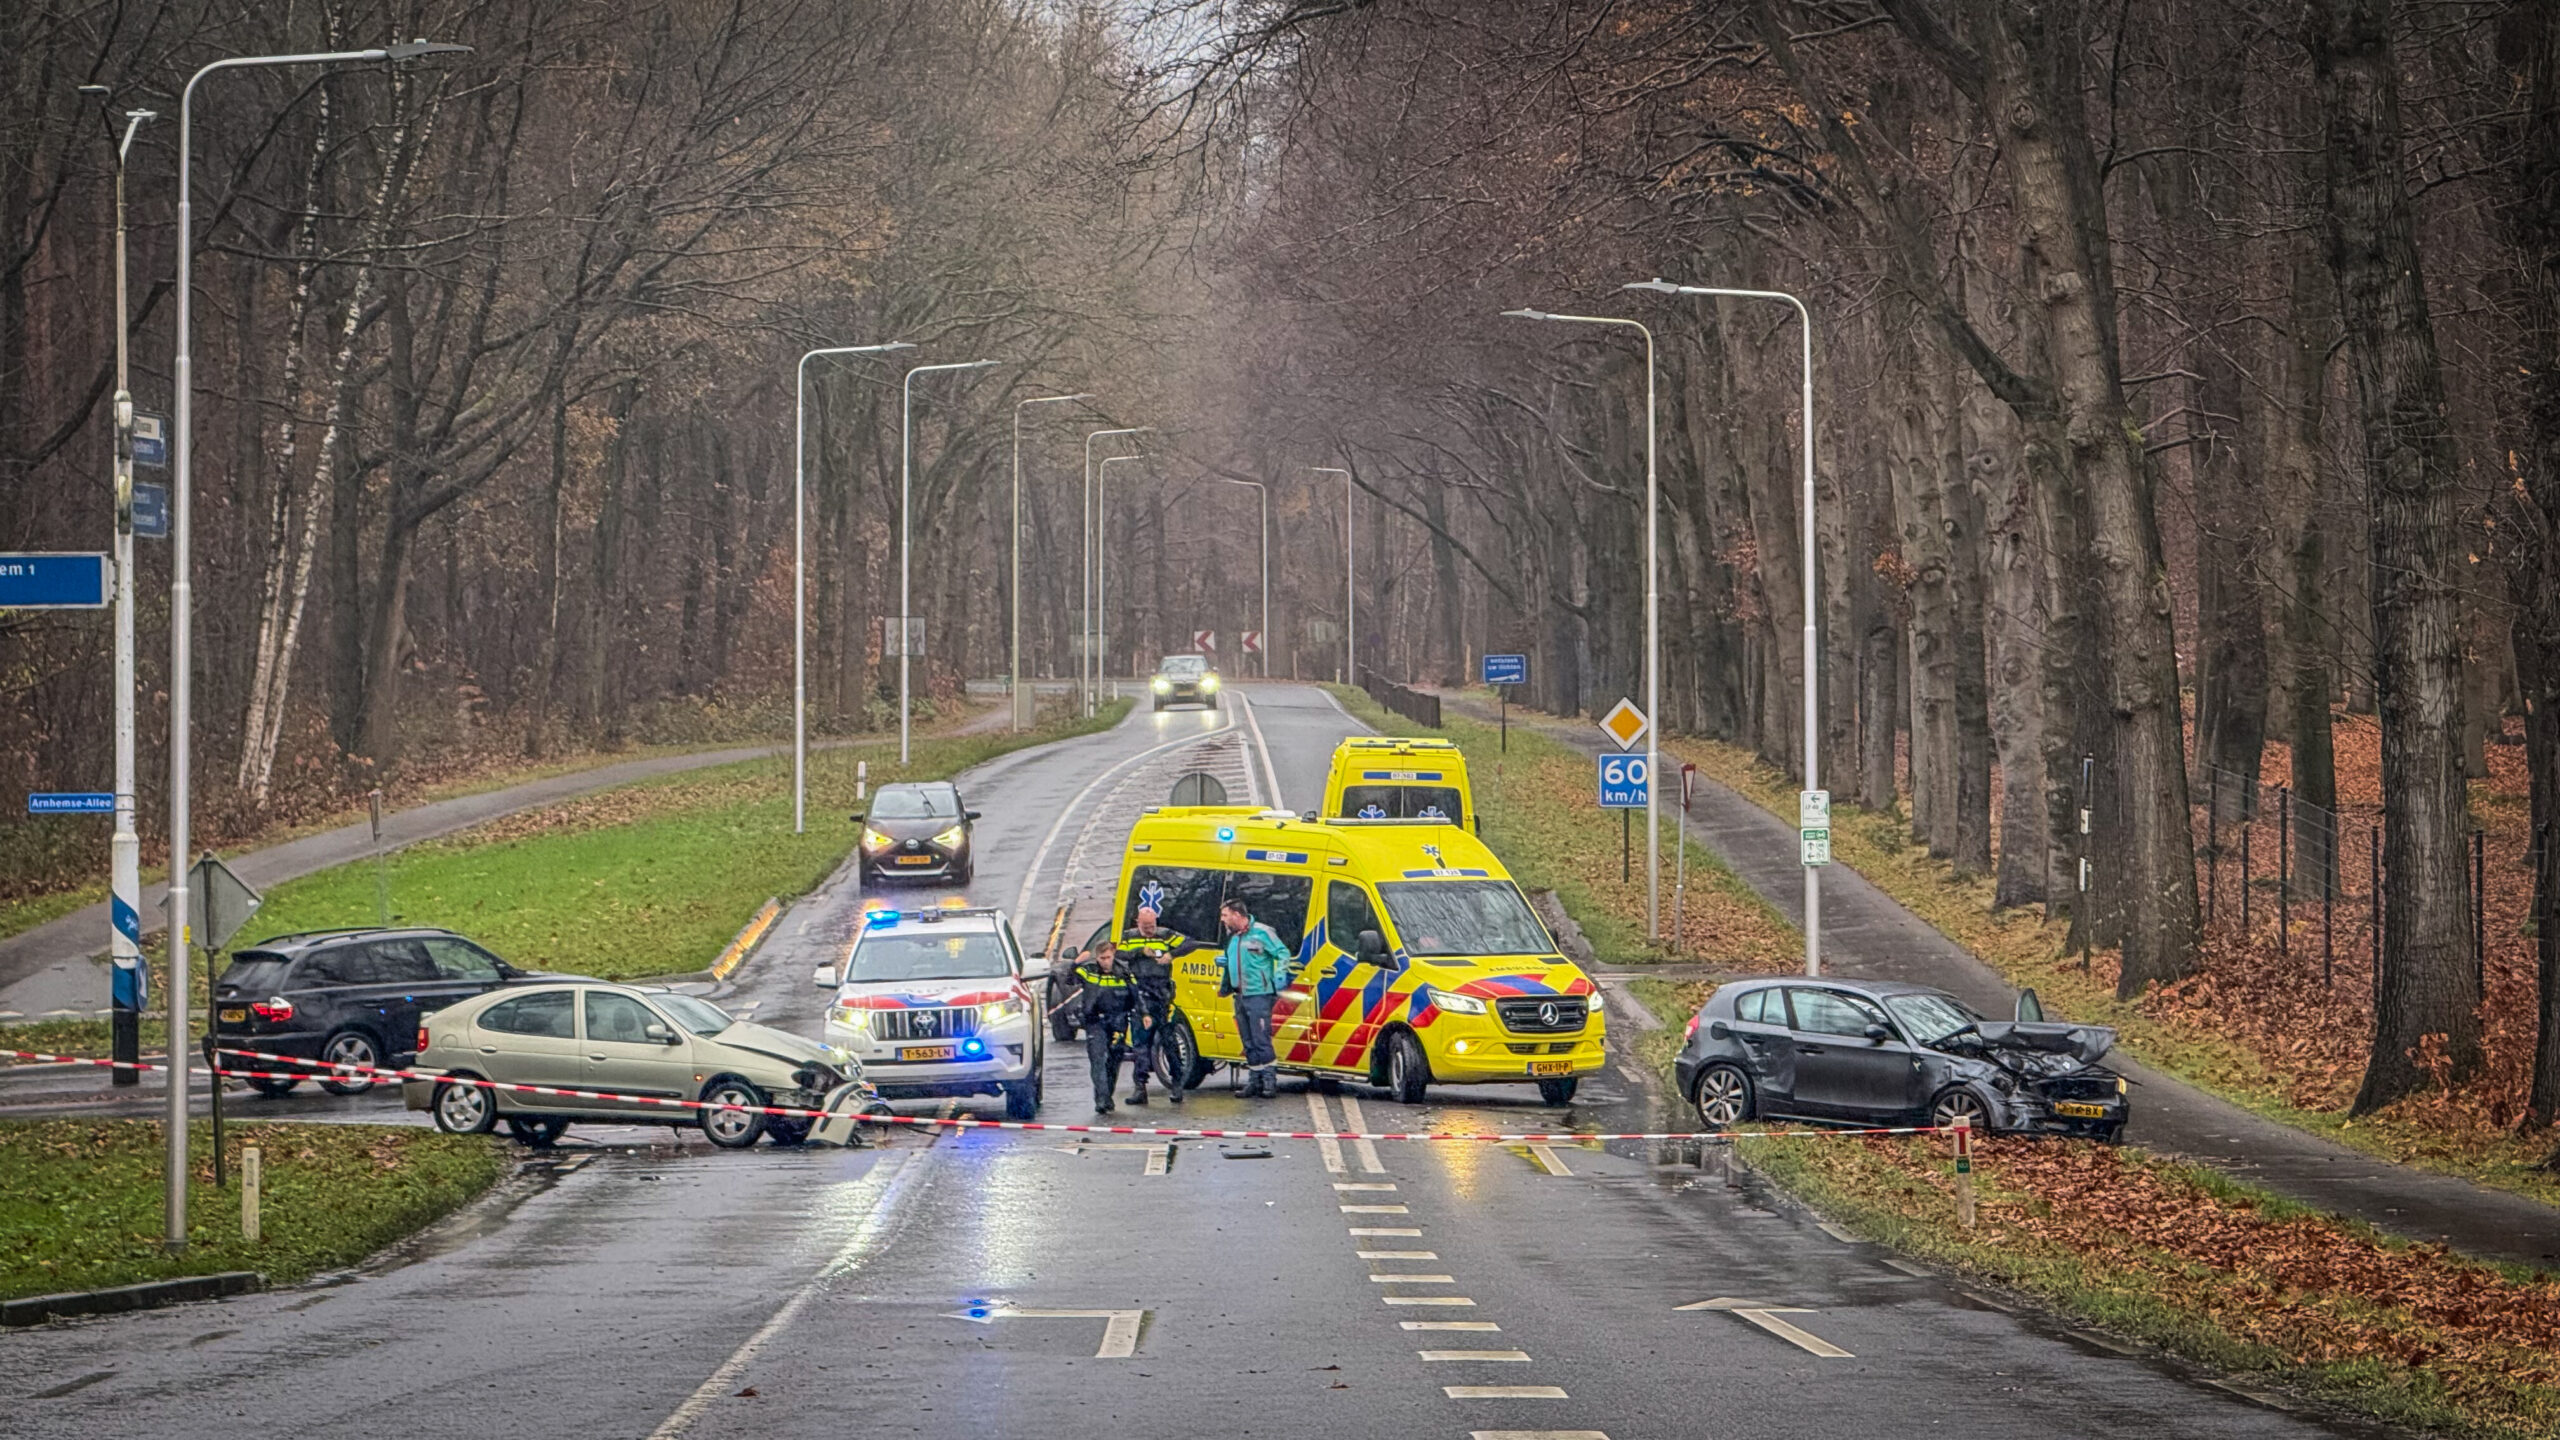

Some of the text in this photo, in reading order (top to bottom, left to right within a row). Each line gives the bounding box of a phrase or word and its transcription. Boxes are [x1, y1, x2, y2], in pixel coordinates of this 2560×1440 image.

[28, 564, 35, 576] 1
[1604, 759, 1647, 785] 60
[1605, 788, 1647, 803] km/h
[31, 798, 111, 808] Arnhemse-Allee
[905, 1048, 951, 1059] T-563-LN
